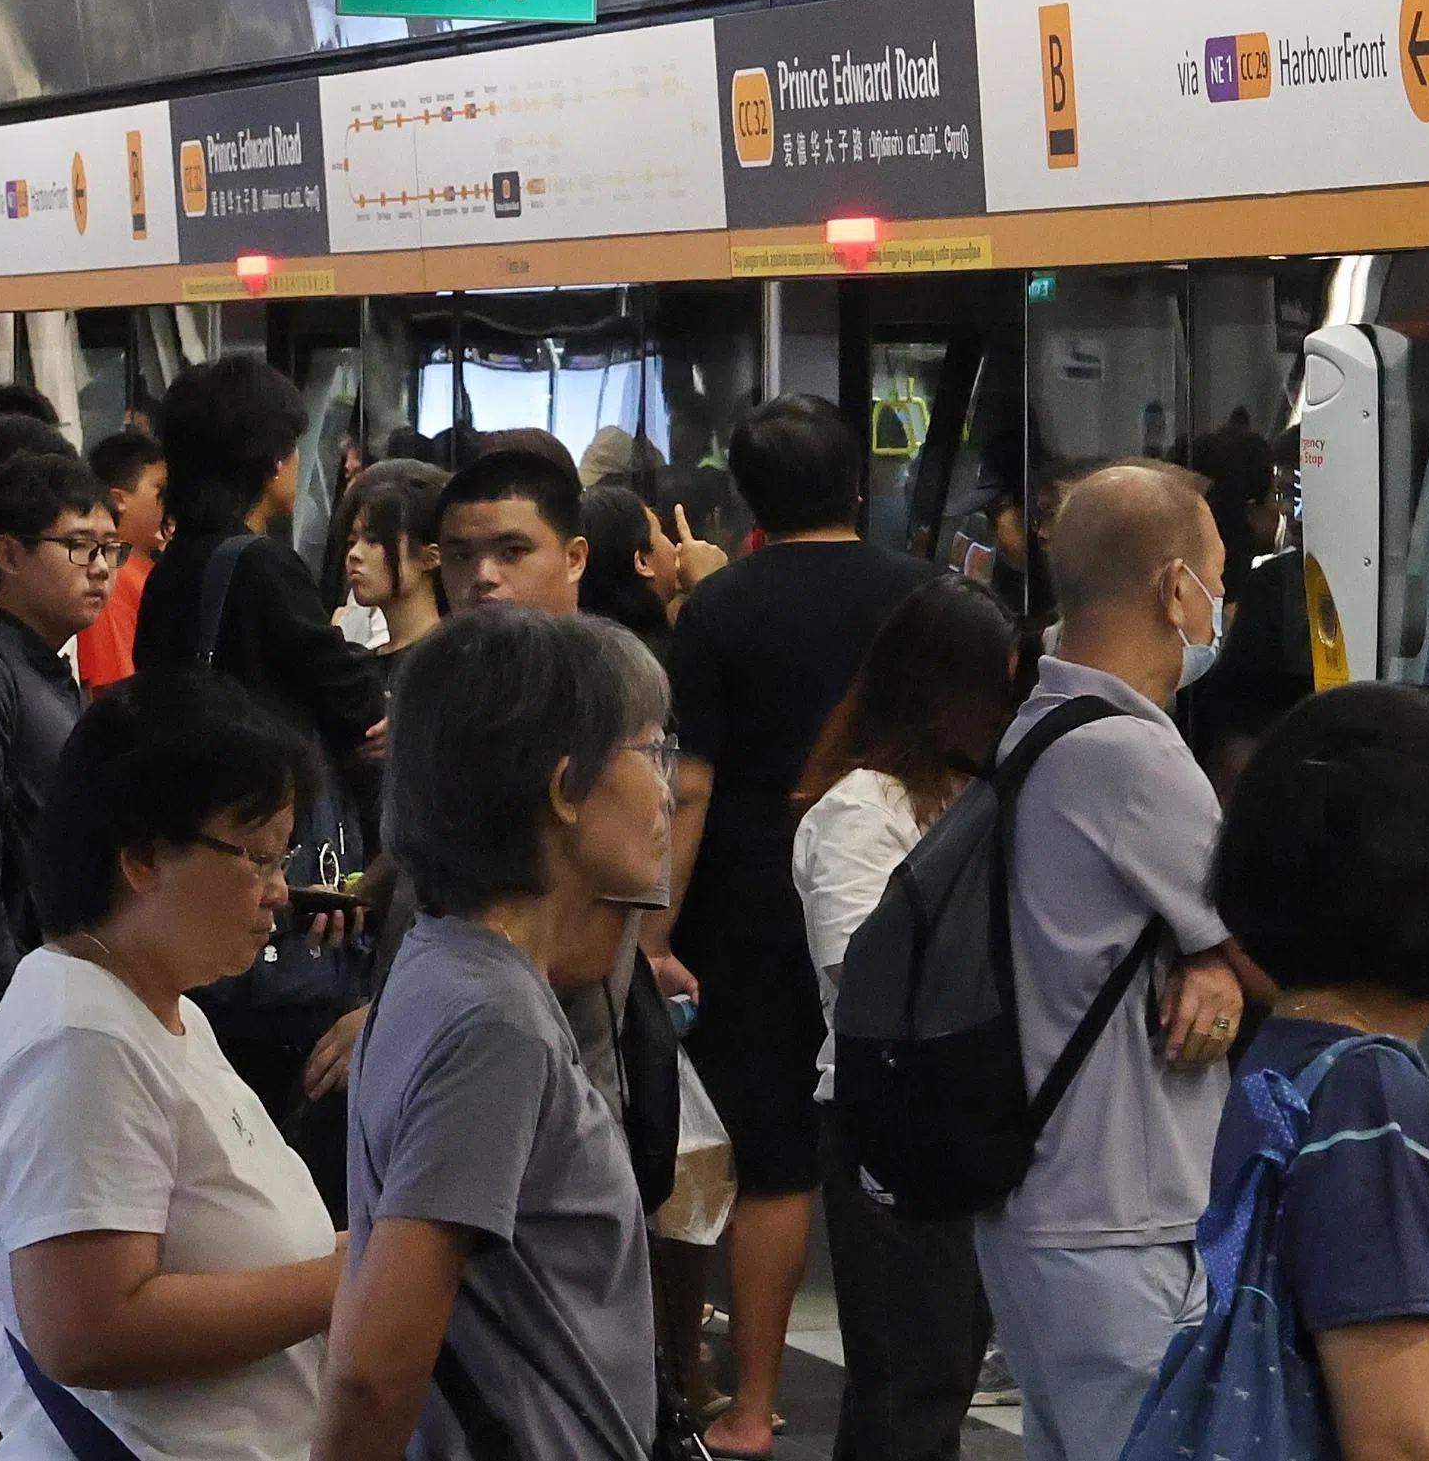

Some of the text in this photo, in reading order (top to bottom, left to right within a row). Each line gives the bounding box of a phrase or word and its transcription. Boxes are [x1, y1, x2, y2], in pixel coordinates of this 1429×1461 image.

[777, 39, 940, 110] Prince Edward Road
[1047, 34, 1065, 114] B
[1178, 50, 1199, 96] via
[1279, 32, 1388, 87] HarbourFront
